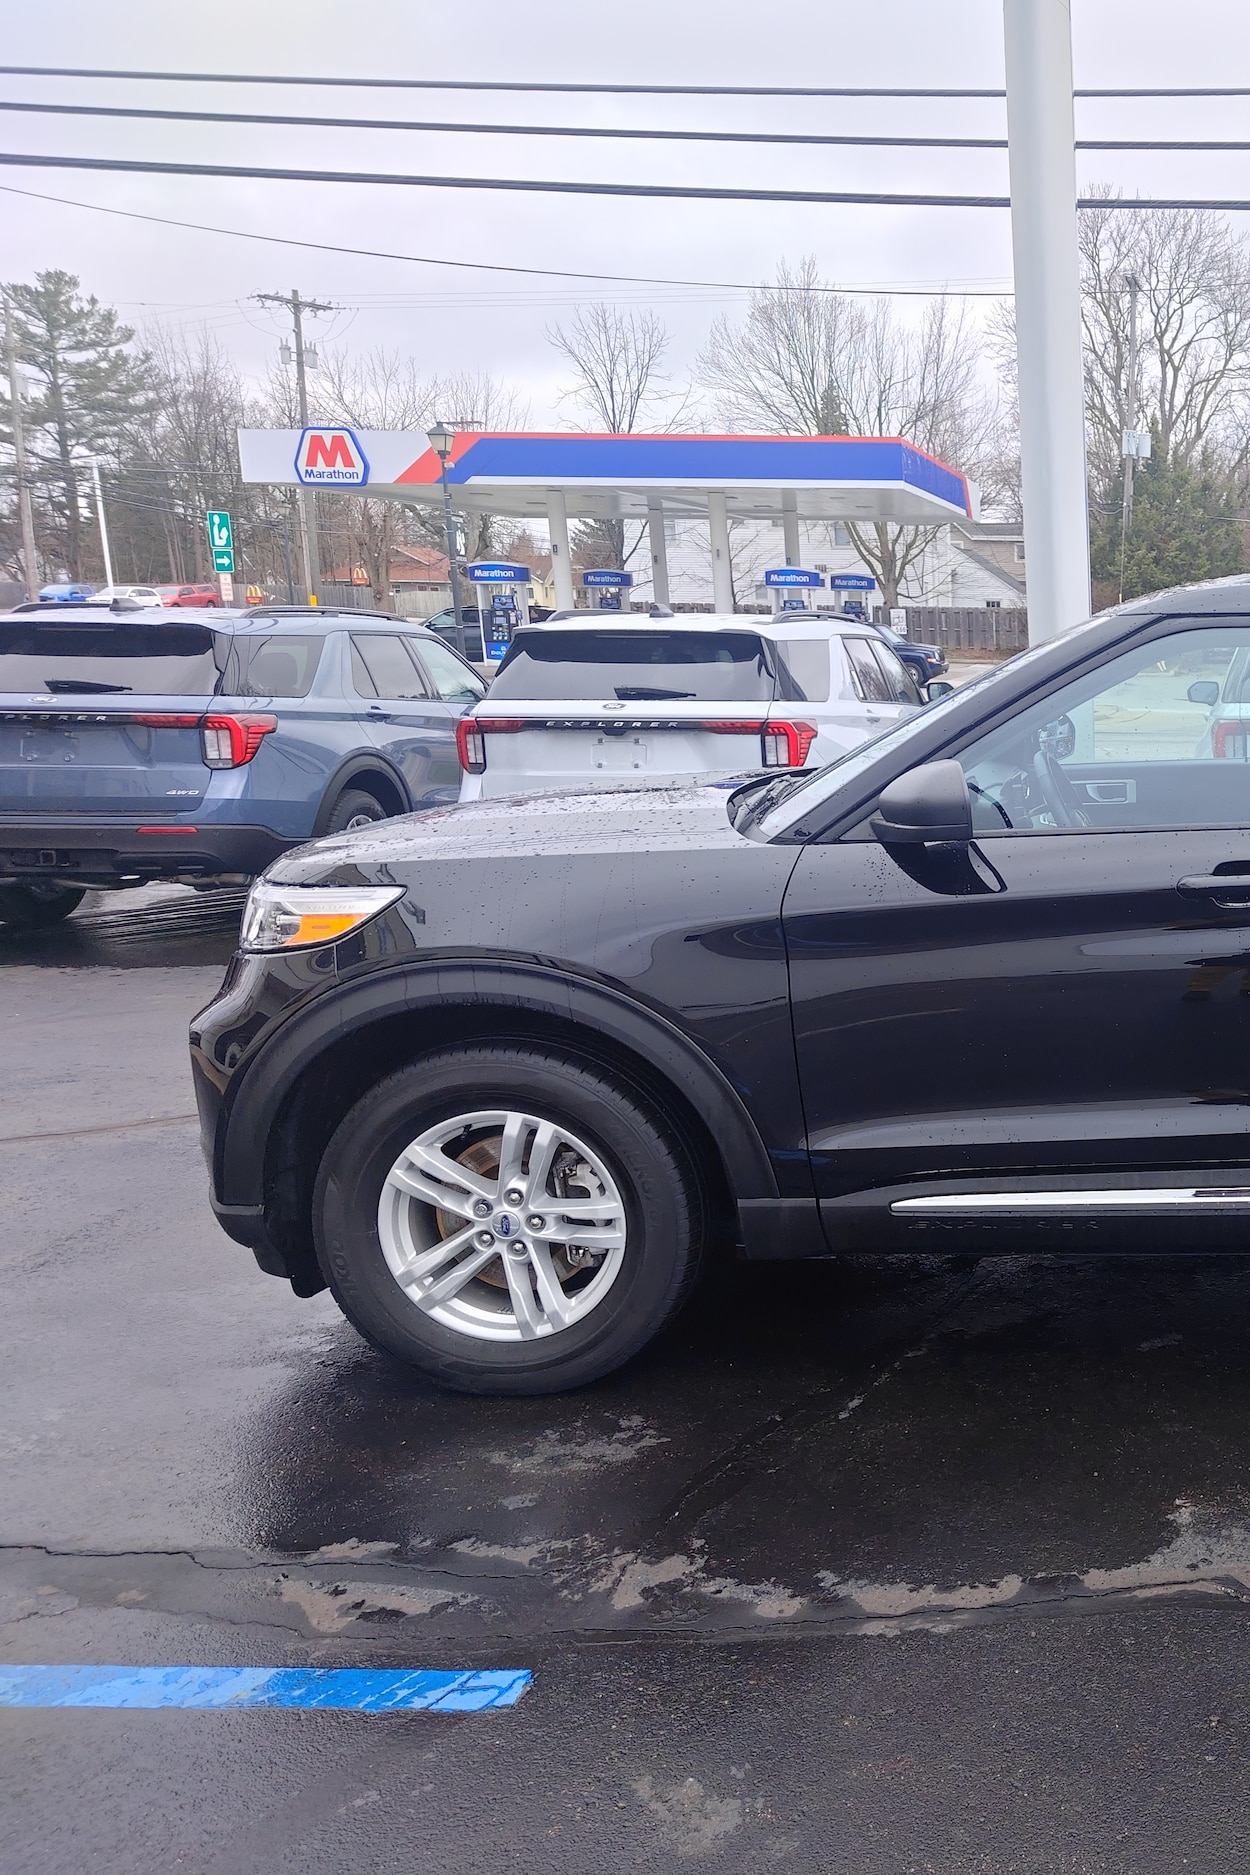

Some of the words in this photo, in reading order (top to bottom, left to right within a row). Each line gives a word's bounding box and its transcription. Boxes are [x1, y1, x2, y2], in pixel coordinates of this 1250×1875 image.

[305, 434, 356, 468] M
[304, 469, 359, 480] Marathon
[474, 568, 514, 578] Marathon
[587, 575, 622, 583] Marathon
[770, 574, 810, 583] Marathon
[834, 578, 868, 587] Marathon
